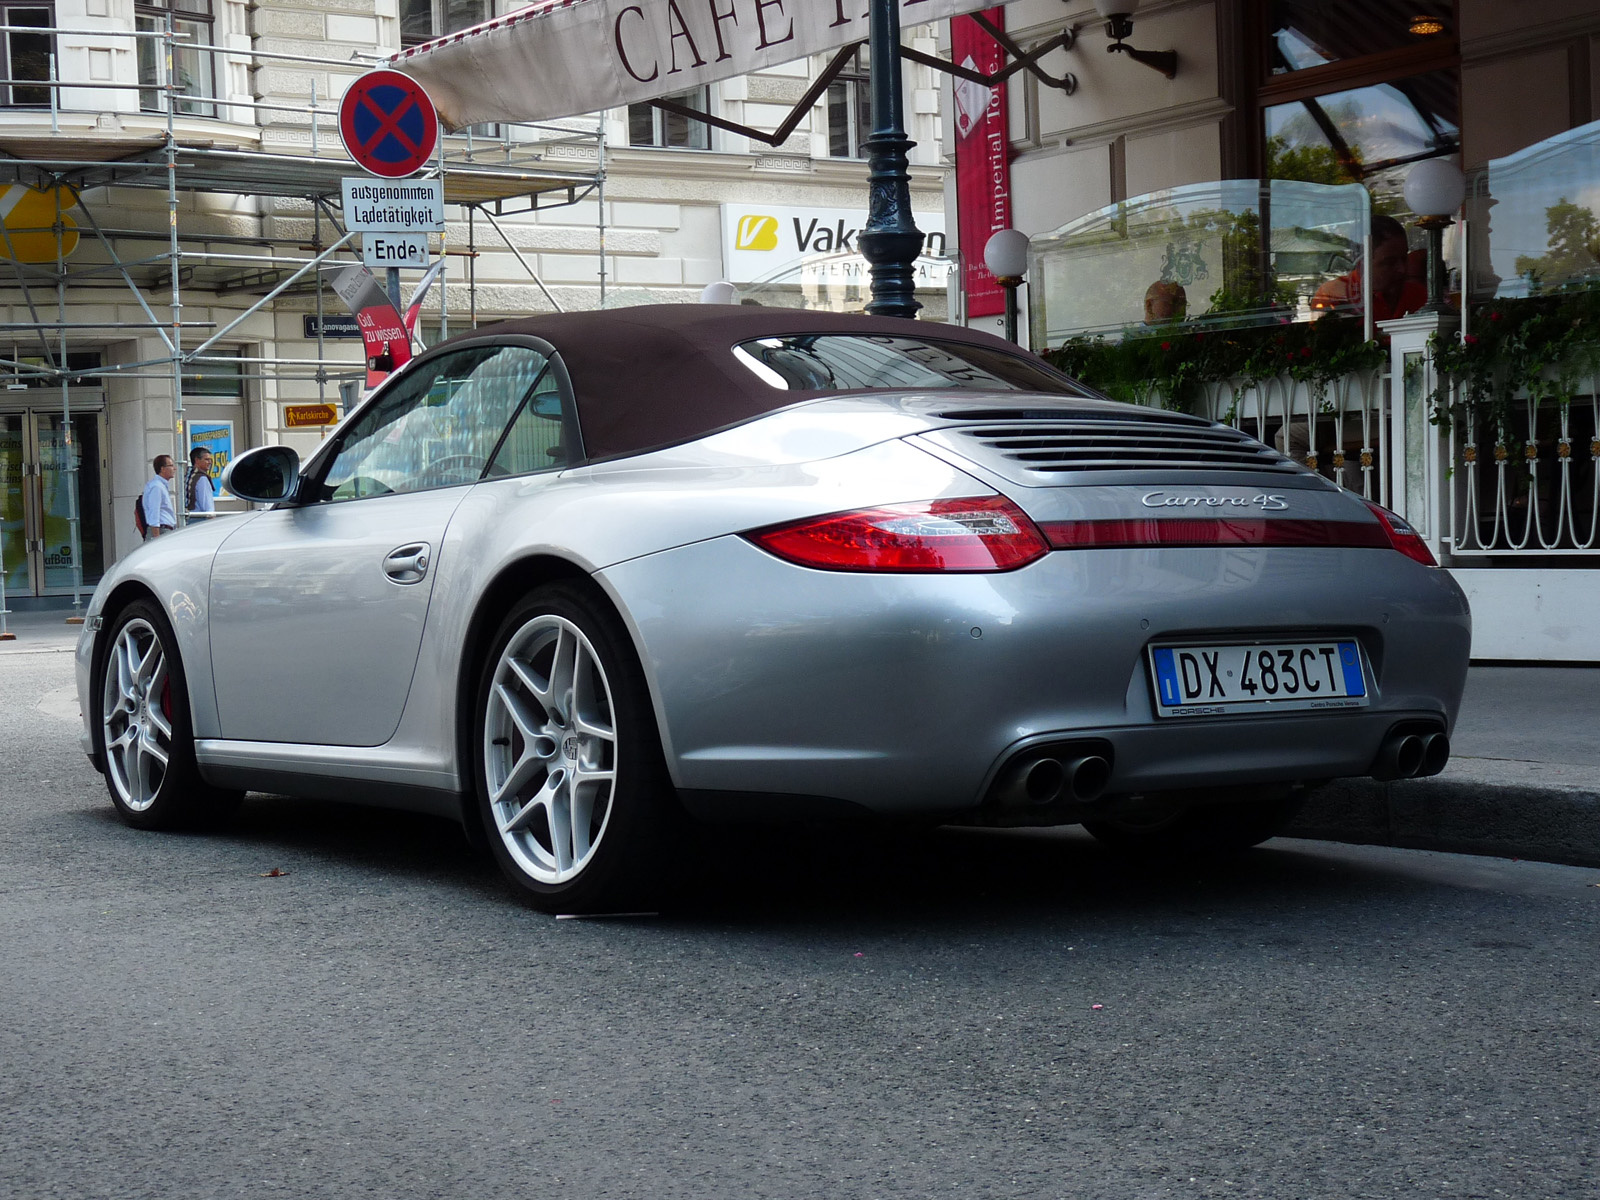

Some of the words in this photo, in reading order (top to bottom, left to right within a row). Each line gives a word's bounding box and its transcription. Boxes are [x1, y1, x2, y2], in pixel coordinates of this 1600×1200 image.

[987, 131, 1008, 233] Imperial
[351, 186, 434, 203] ausgenommen
[354, 206, 434, 227] Ladetätigkeit
[375, 240, 417, 260] Ende
[357, 312, 375, 327] Gut
[365, 331, 376, 342] zu
[376, 326, 406, 341] wissen.
[296, 411, 330, 420] Karlskirche
[1142, 491, 1250, 508] Carrera
[1253, 494, 1289, 511] 4S
[1179, 651, 1227, 699] DX
[1240, 648, 1336, 696] 483CT
[1171, 706, 1226, 715] PORSCHE
